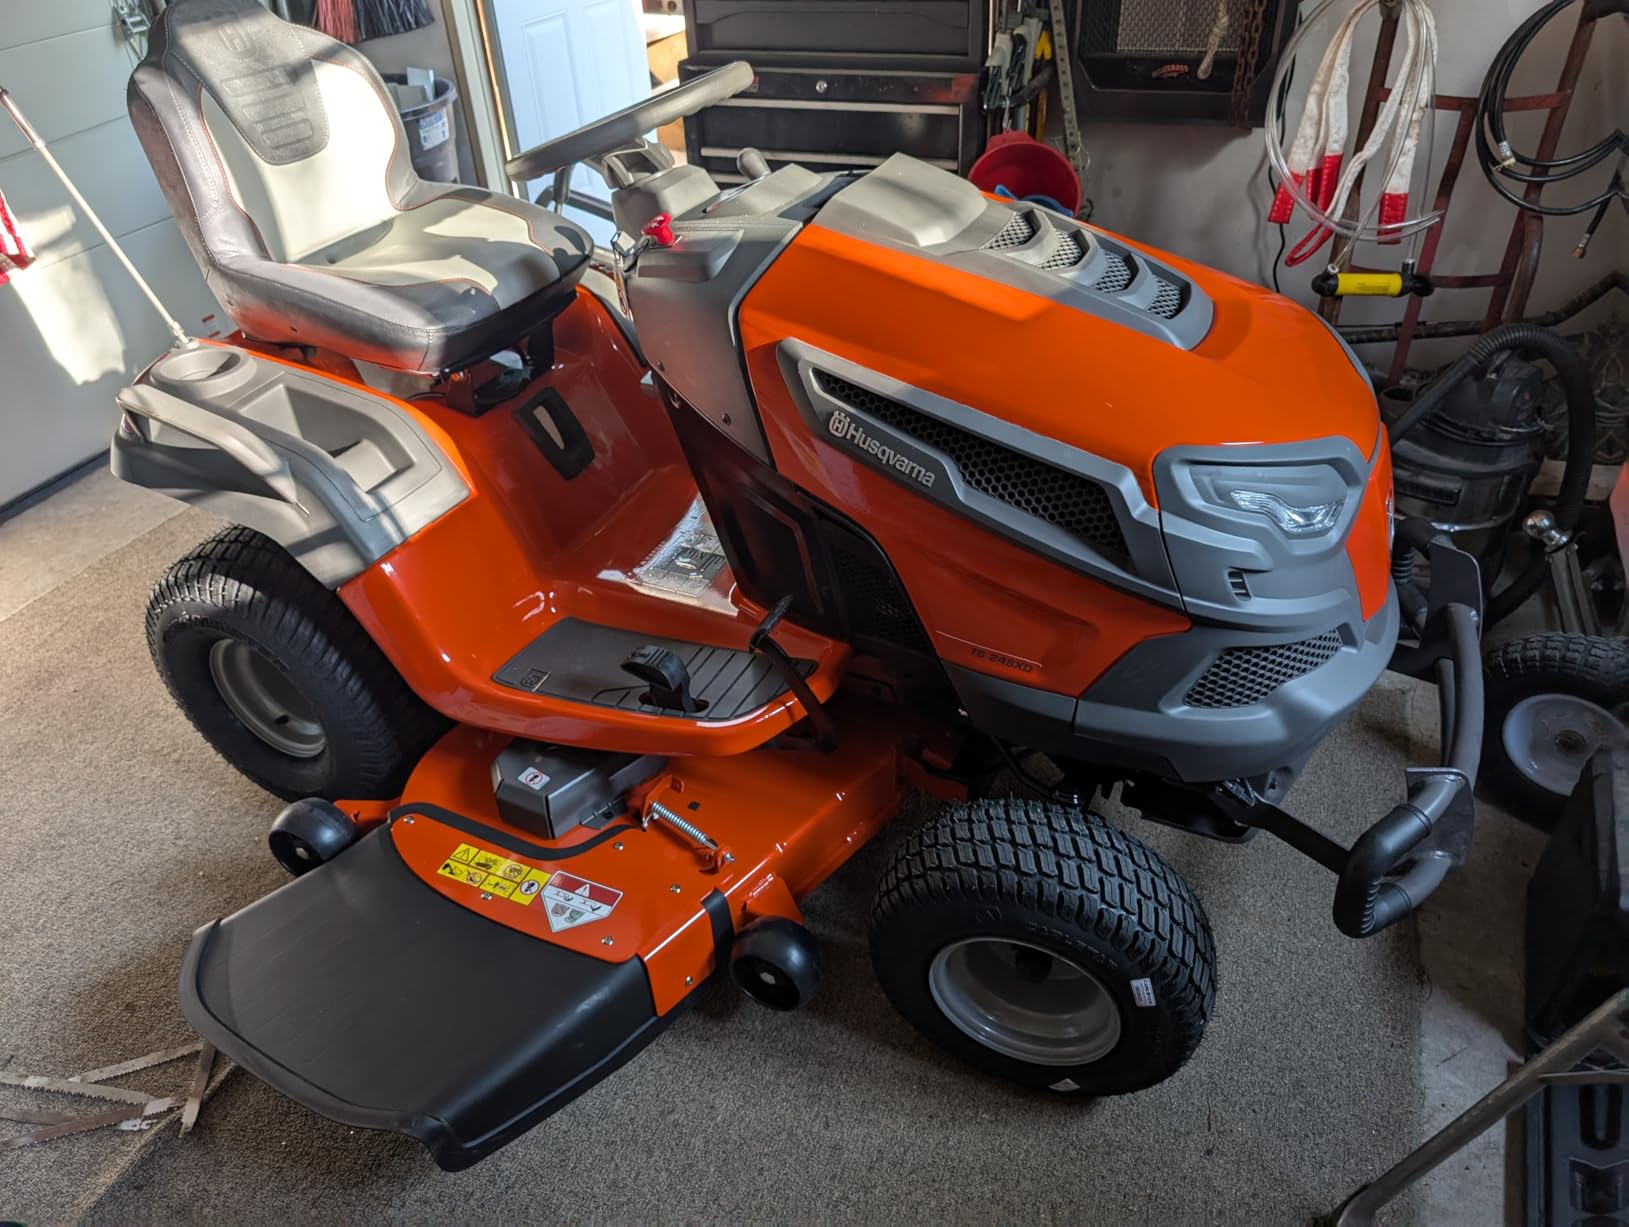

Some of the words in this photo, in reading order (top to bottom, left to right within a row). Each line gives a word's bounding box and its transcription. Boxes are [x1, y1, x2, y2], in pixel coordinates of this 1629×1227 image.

[846, 423, 936, 487] Husqvarna
[971, 647, 986, 657] TS
[989, 653, 1033, 672] 248XD
